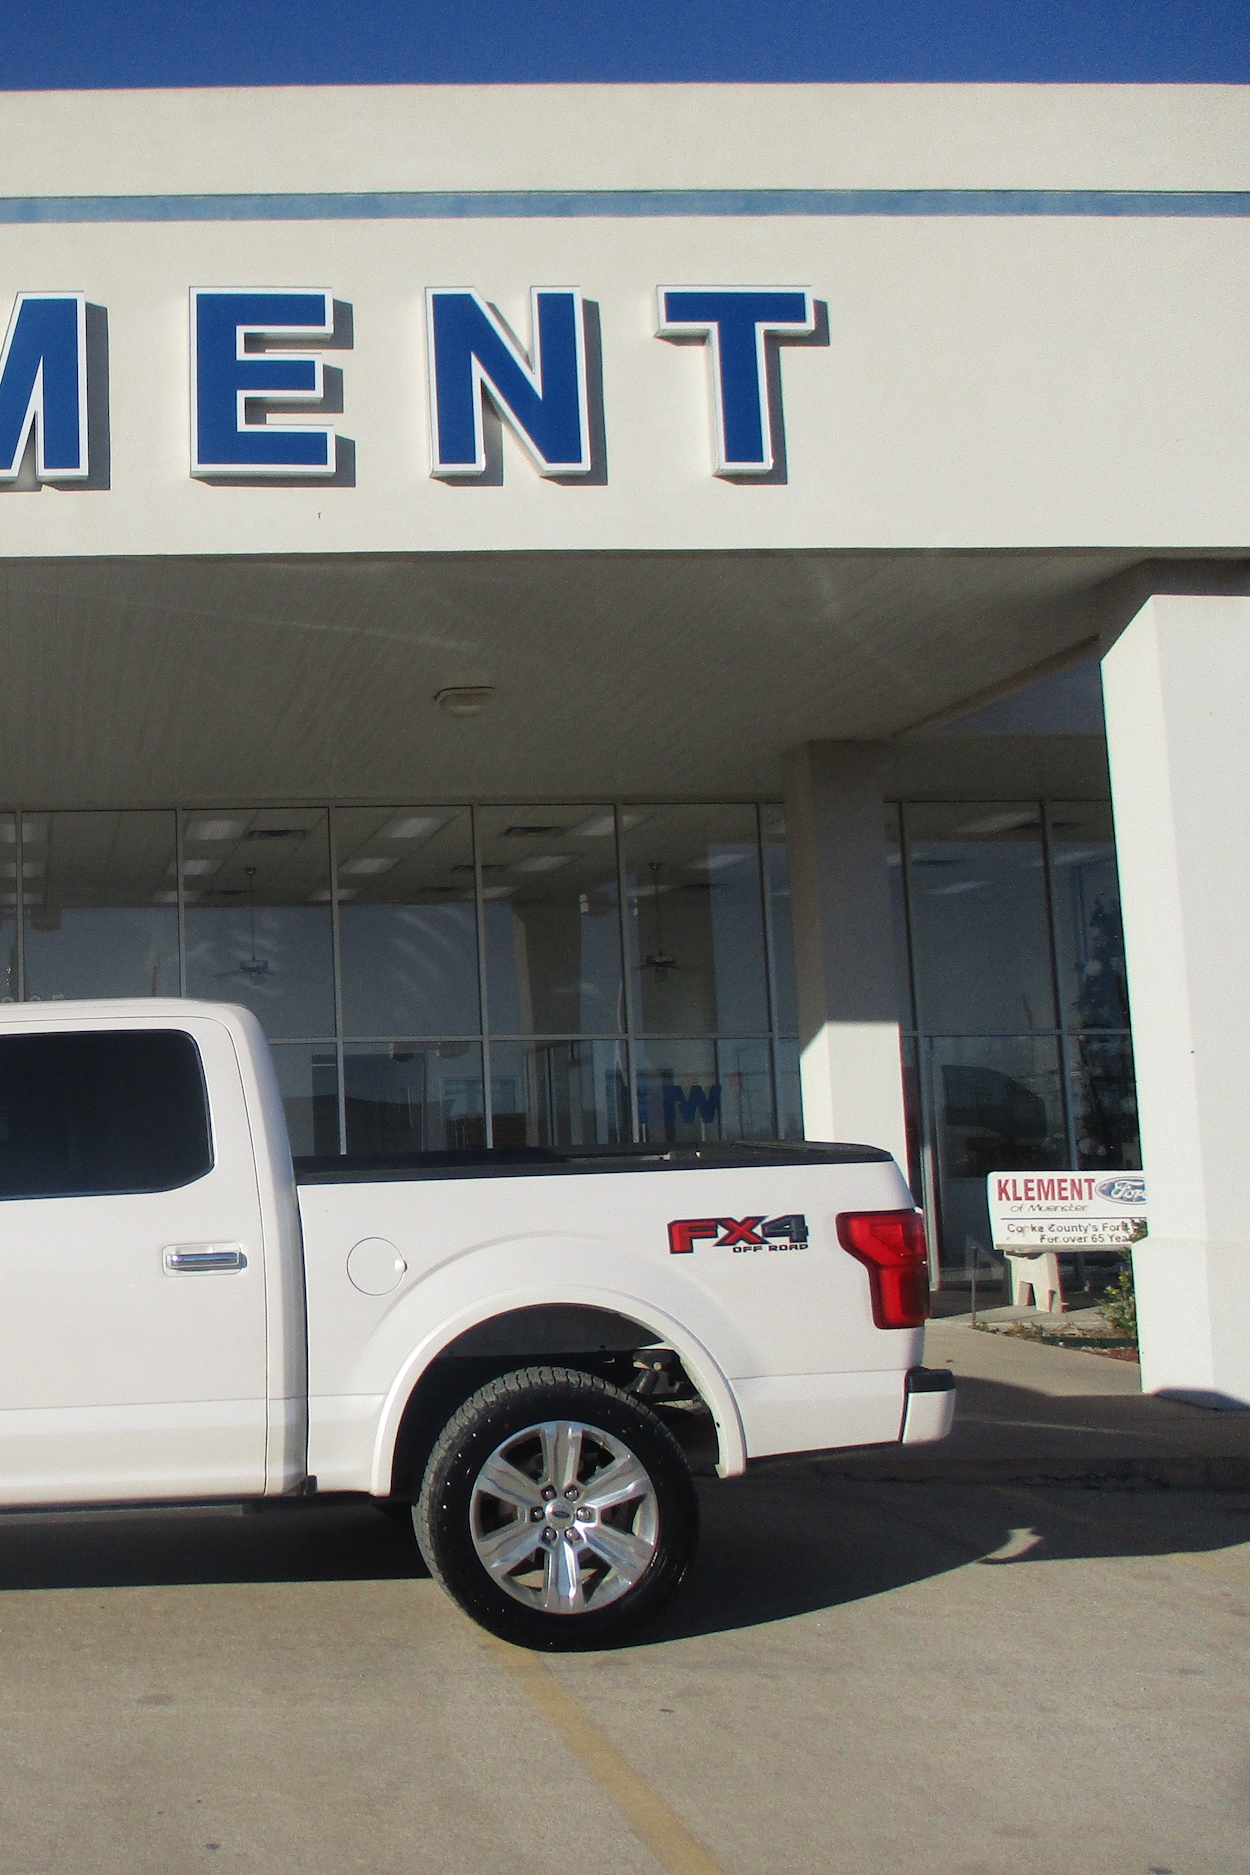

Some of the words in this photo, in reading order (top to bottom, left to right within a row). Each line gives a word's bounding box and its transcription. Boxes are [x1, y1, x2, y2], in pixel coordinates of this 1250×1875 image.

[997, 1178, 1096, 1201] KLEMENT
[1010, 1204, 1024, 1212] of
[1027, 1203, 1089, 1212] Muenster
[1007, 1223, 1044, 1234] Coke
[1048, 1222, 1098, 1234] County's
[667, 1214, 808, 1254] FX4
[1040, 1234, 1060, 1243] For
[1062, 1234, 1088, 1243] over
[1091, 1233, 1105, 1243] 65
[732, 1245, 763, 1253] OFF
[768, 1243, 809, 1252] ROAD
